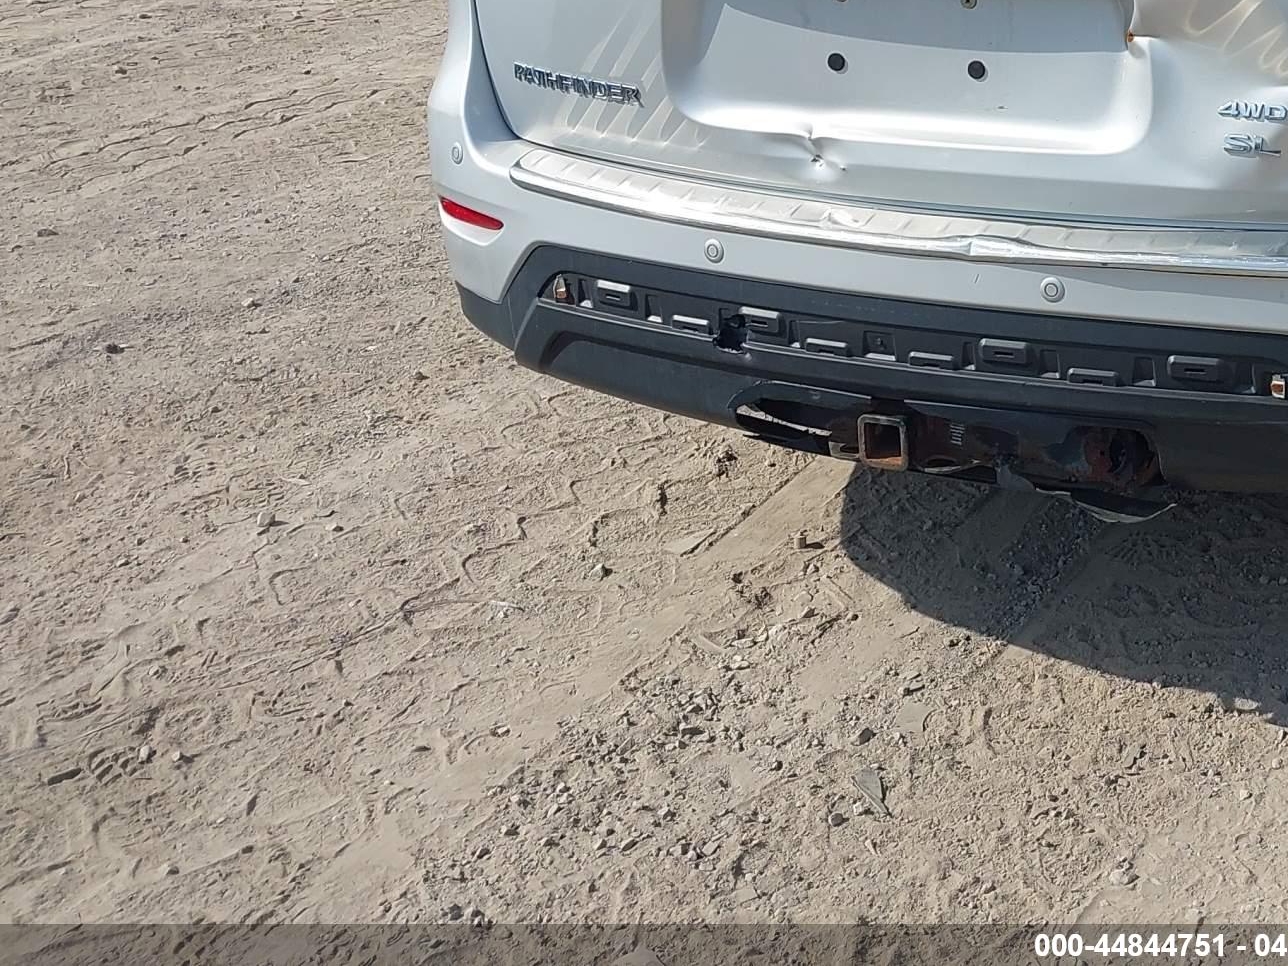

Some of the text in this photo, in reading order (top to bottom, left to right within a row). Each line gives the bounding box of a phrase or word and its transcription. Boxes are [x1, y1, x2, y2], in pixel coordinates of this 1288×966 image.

[513, 61, 643, 107] PATHFINDER
[1217, 101, 1288, 121] 4WD
[1223, 133, 1282, 157] SL
